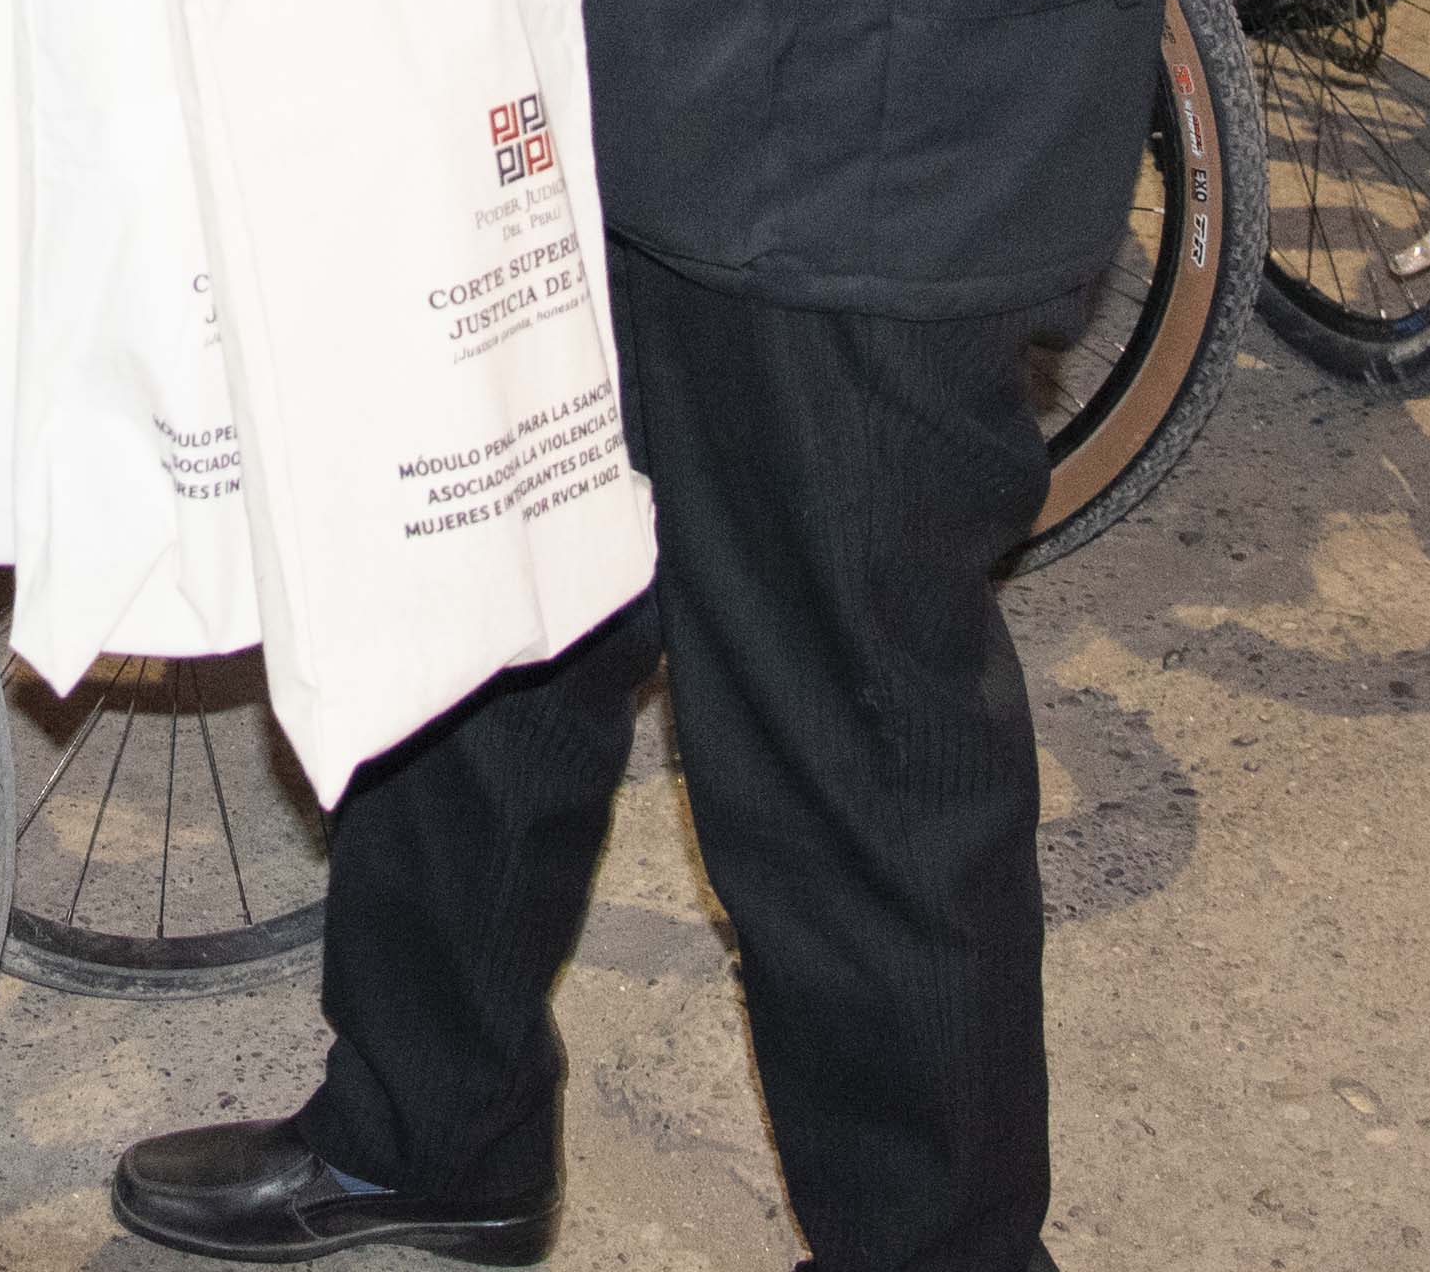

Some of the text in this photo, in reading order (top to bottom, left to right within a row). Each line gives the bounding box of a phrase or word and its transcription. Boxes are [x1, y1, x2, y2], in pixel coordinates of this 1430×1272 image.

[1191, 167, 1207, 203] EXO
[474, 197, 522, 229] PODER
[1191, 213, 1208, 268] TR
[428, 267, 505, 310] CORTE
[449, 271, 572, 340] JUSTICIA DE
[398, 449, 481, 480] MÓDULO
[517, 410, 549, 436] PARA
[552, 402, 570, 423] LA
[523, 445, 538, 466] LA
[539, 414, 607, 457] VIOLENCIA
[405, 506, 490, 539] MUJERES
[494, 500, 503, 516] E
[580, 447, 601, 467] DEL
[592, 463, 621, 491] 1002
